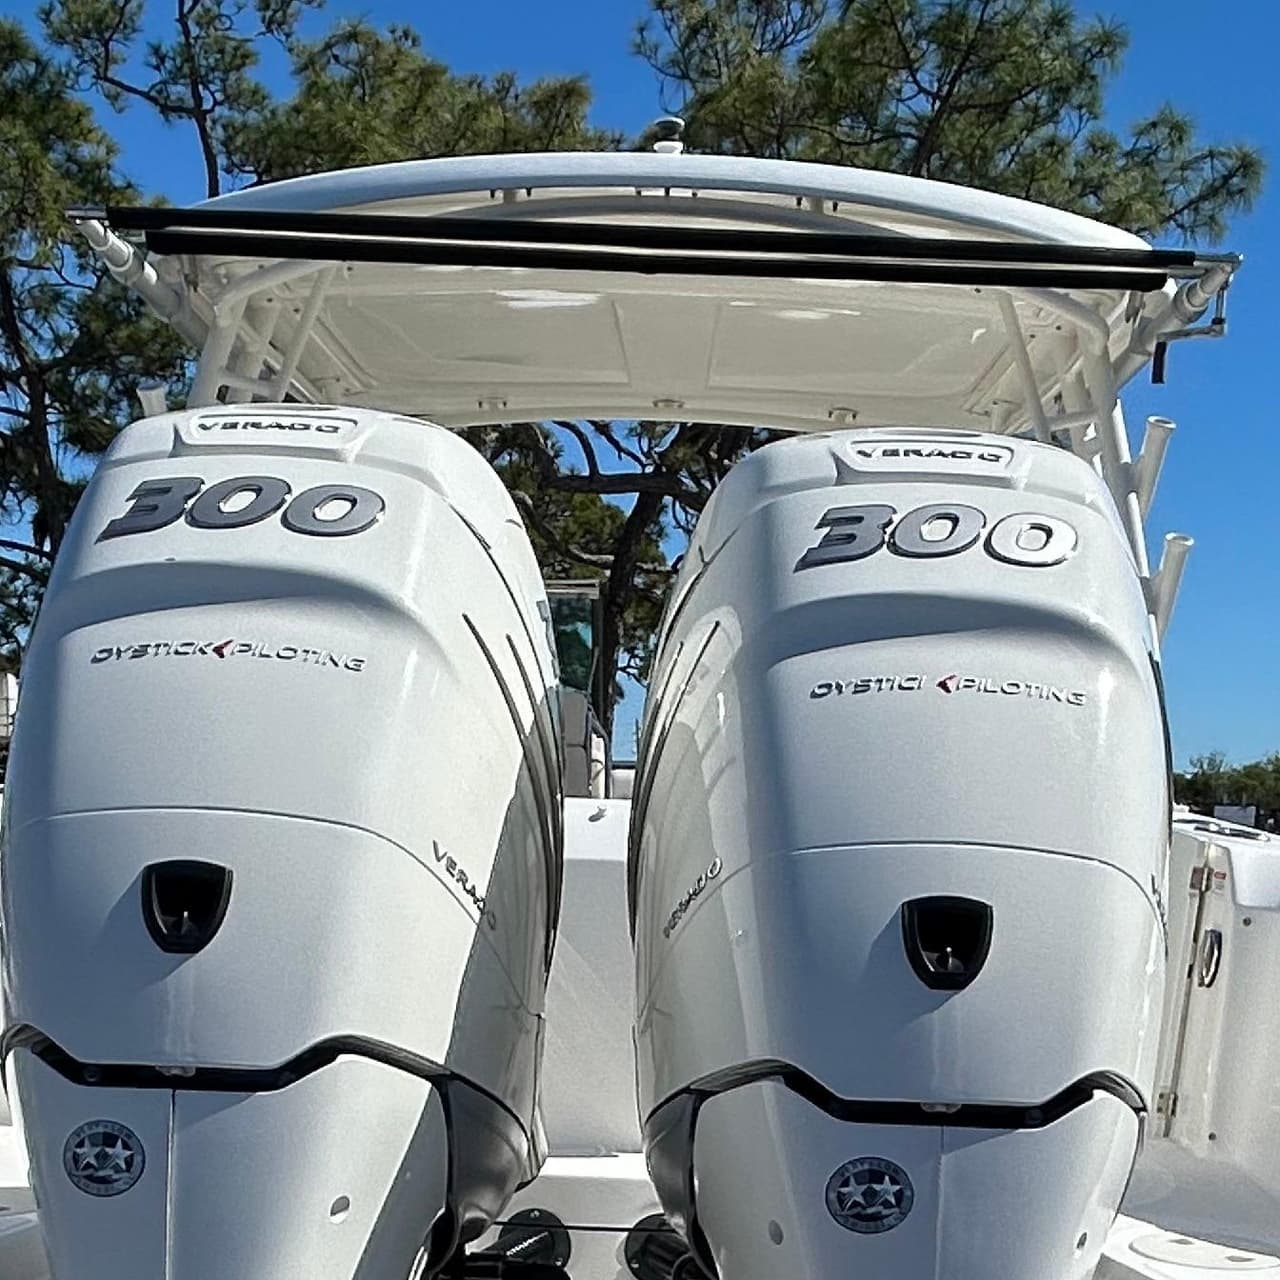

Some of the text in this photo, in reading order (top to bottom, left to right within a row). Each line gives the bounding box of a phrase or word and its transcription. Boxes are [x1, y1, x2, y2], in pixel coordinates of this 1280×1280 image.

[94, 476, 387, 545] 300
[793, 503, 1080, 574] 300
[231, 641, 366, 673] PILOTING
[955, 677, 1088, 707] PILOTING
